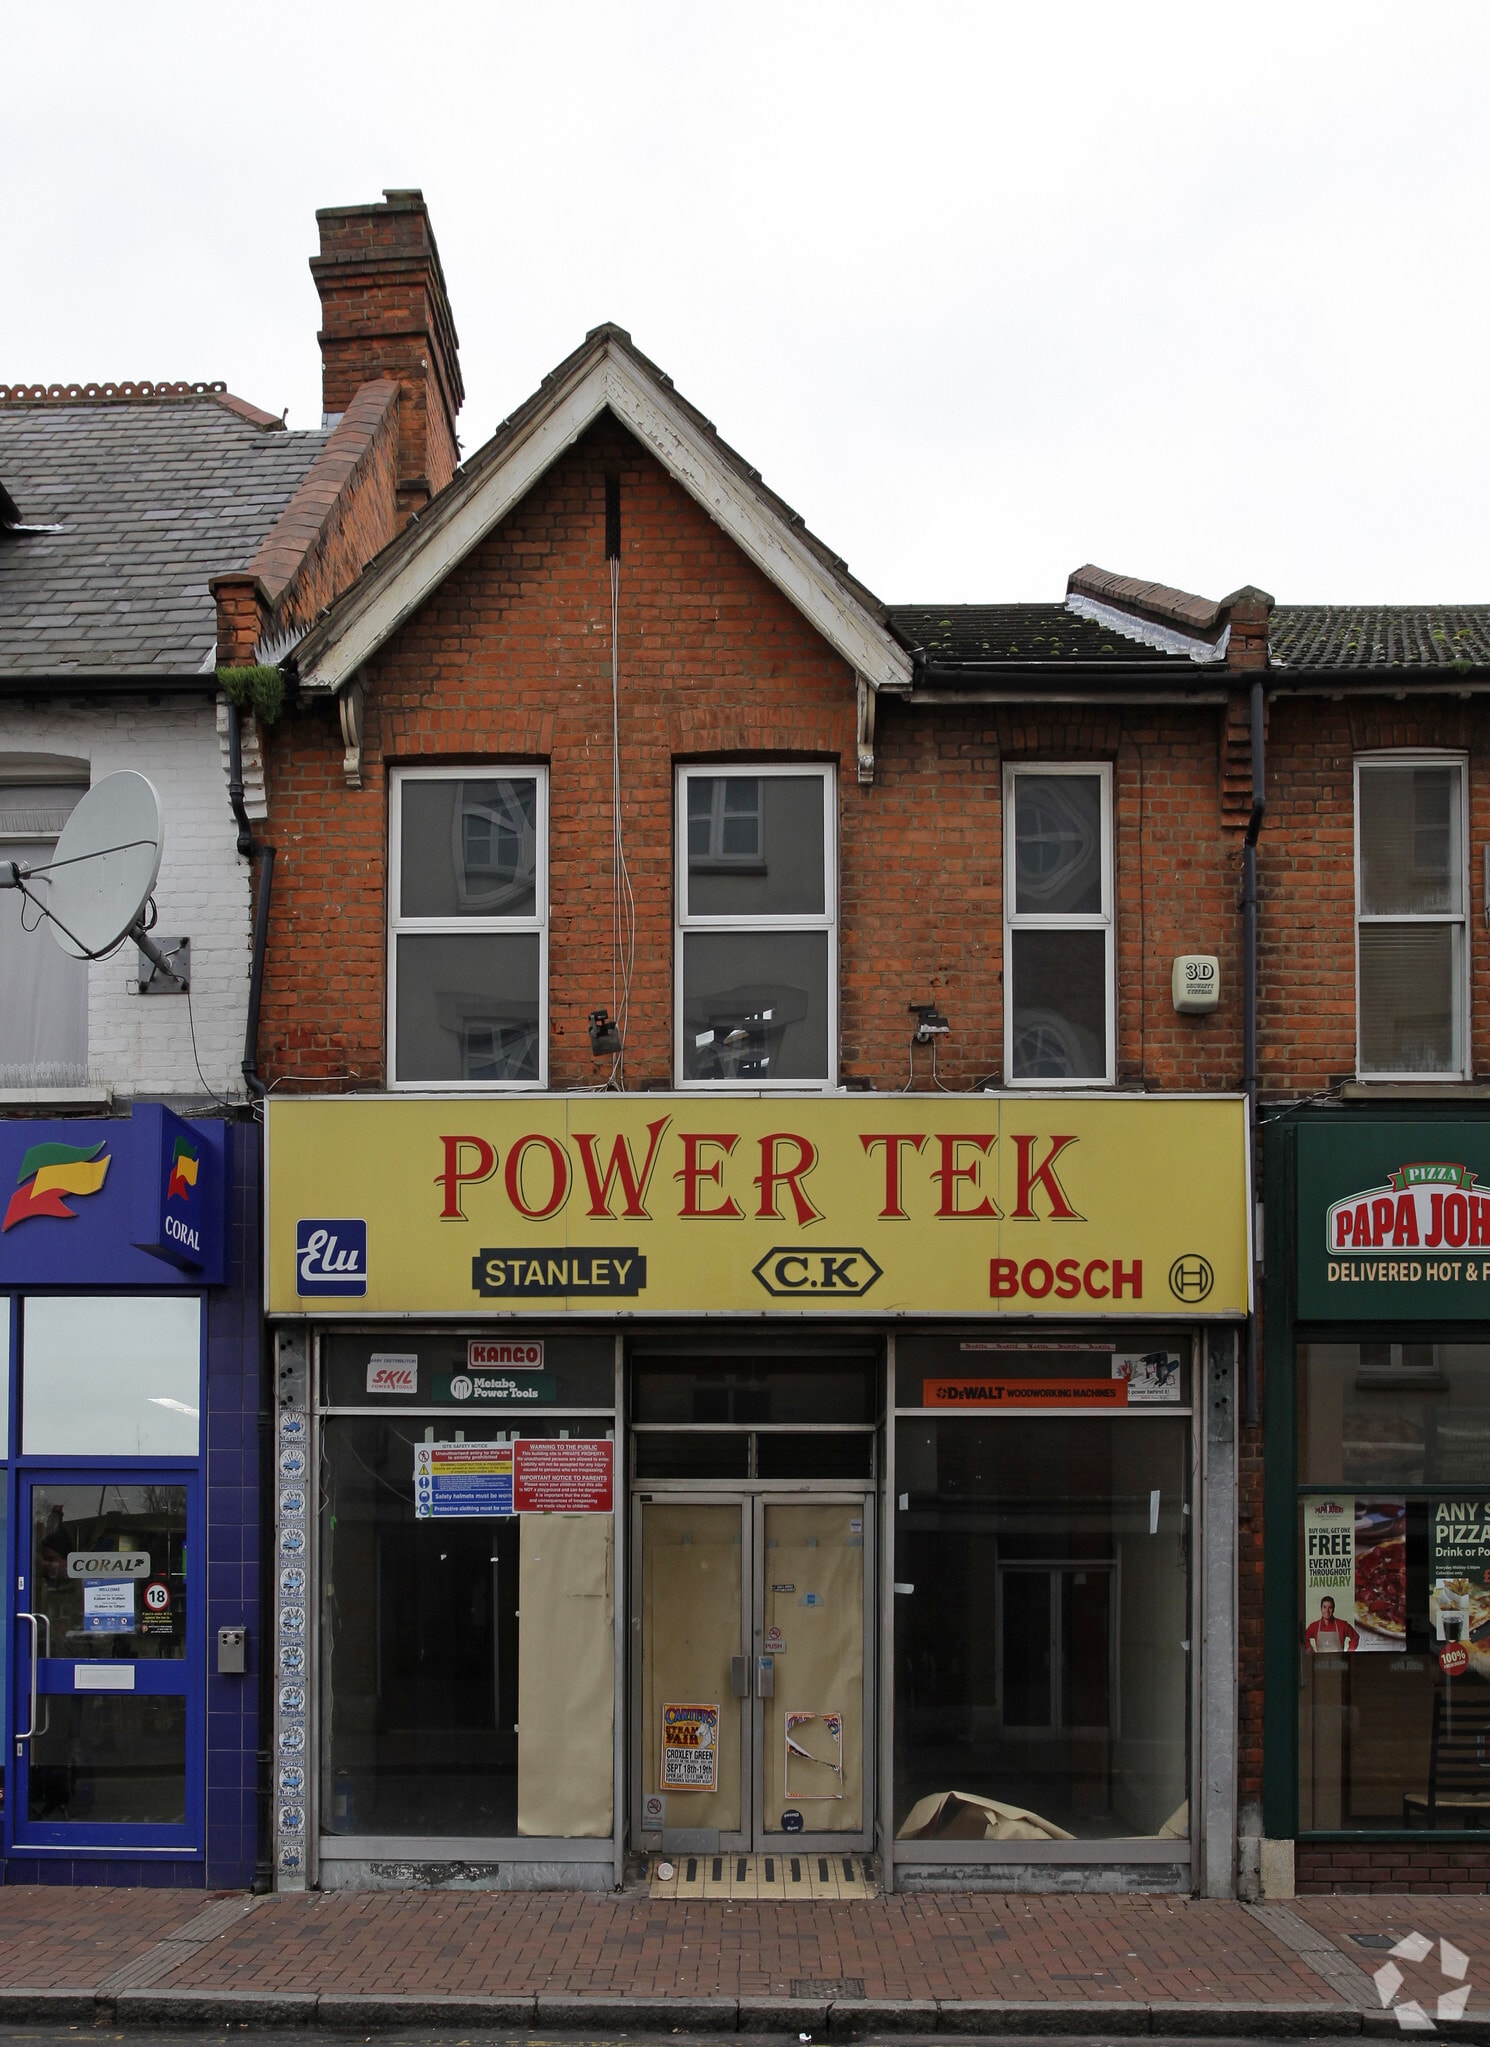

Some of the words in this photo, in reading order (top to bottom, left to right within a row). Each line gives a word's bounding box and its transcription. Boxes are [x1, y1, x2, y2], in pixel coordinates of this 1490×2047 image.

[1186, 963, 1214, 980] 3D
[433, 1113, 826, 1229] POWER
[858, 1134, 1088, 1222] TEK
[1408, 1167, 1458, 1181] PIZZA
[1336, 1194, 1420, 1247] PAPA
[165, 1215, 200, 1251] CORAL
[297, 1229, 366, 1281] Elu
[485, 1260, 632, 1287] STANLEY
[774, 1256, 859, 1288] C.K
[989, 1258, 1143, 1299] BOSCH
[1327, 1262, 1422, 1282] DELIVERED
[1426, 1262, 1462, 1282] HOT
[1465, 1262, 1478, 1282] &
[473, 1347, 538, 1362] KANGO
[372, 1370, 413, 1390] SKIL
[474, 1378, 516, 1388] Metabo
[474, 1389, 508, 1398] Power
[509, 1389, 539, 1398] Tools
[1006, 1388, 1072, 1398] WOODWORKING
[1073, 1388, 1116, 1398] MACHINES
[1436, 1503, 1479, 1521] ANY
[1309, 1535, 1351, 1555] FREE
[1436, 1547, 1463, 1557] Drink
[72, 1559, 134, 1571] CORAL
[1309, 1559, 1334, 1568] EVERY
[1336, 1558, 1351, 1568] DAY
[1309, 1576, 1351, 1587] JANUARY
[148, 1590, 166, 1603] 18
[1441, 1650, 1466, 1664] 100%
[666, 1708, 716, 1727] CARTERS
[666, 1734, 699, 1744] FAIR
[667, 1749, 693, 1759] CROXLEY
[694, 1750, 713, 1760] GREEN
[667, 1763, 682, 1772] SEPT
